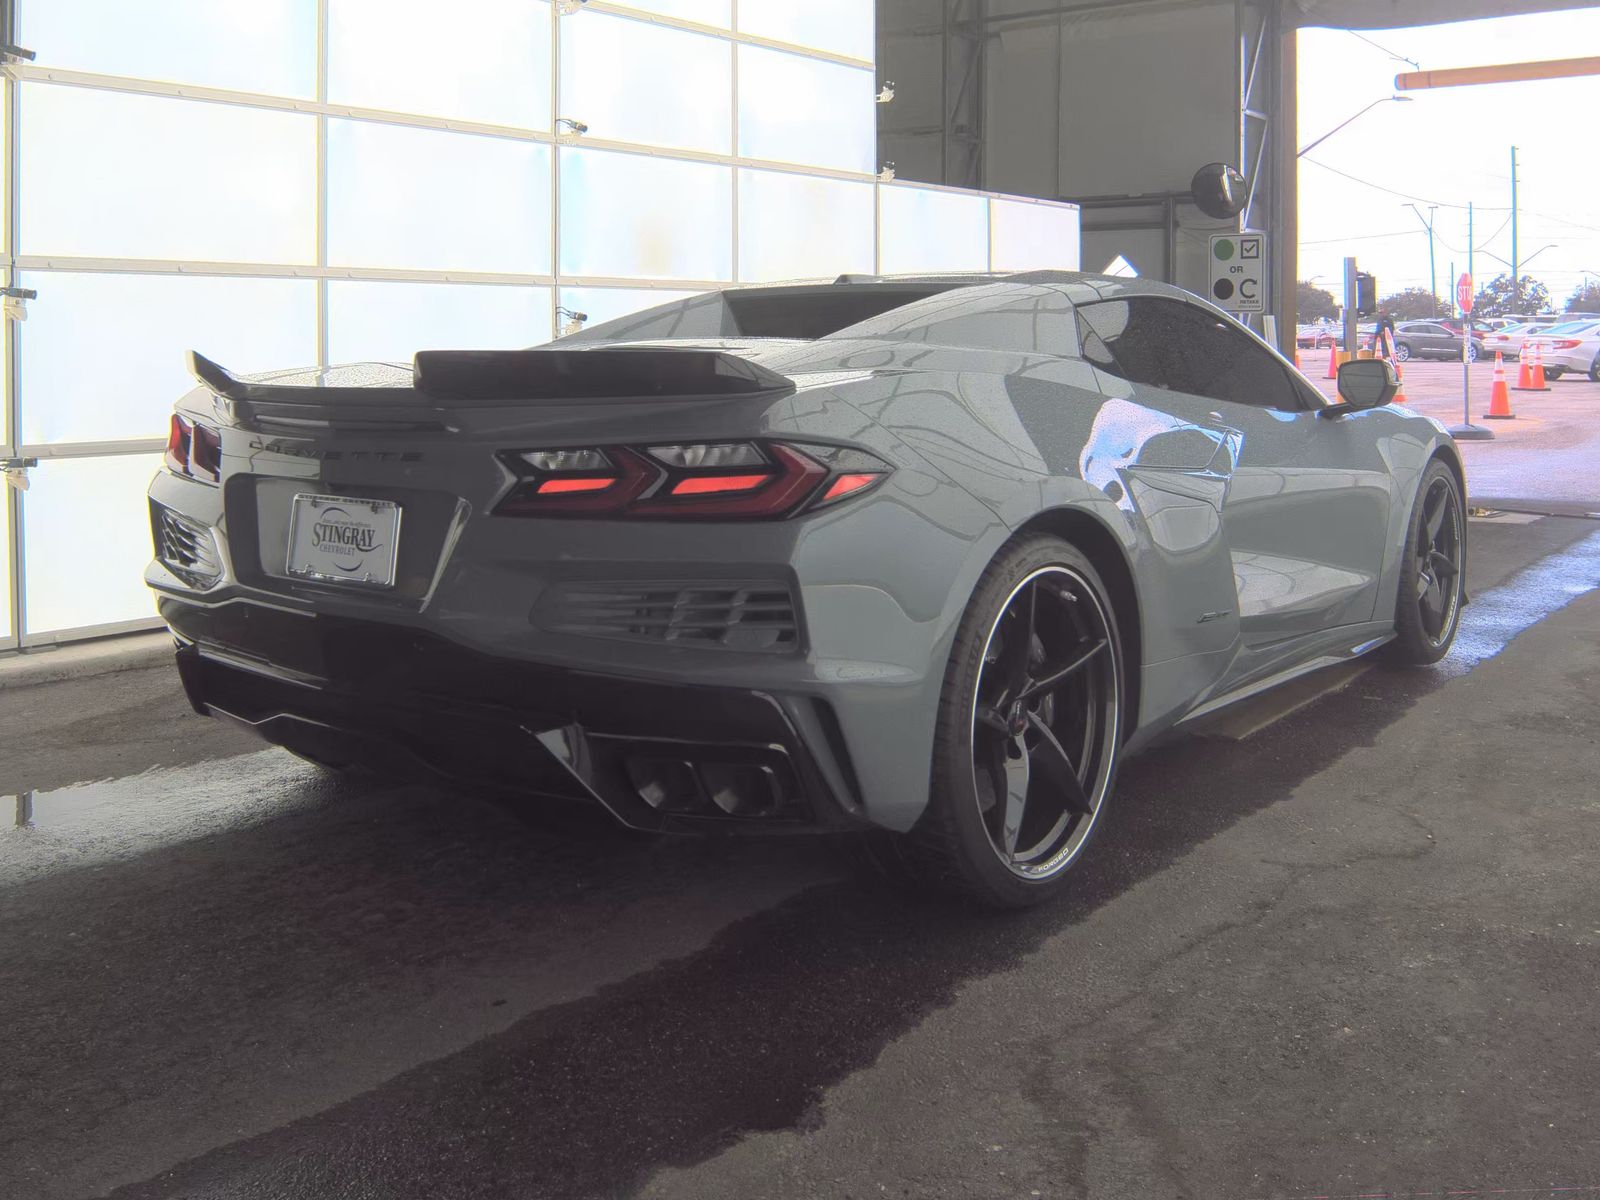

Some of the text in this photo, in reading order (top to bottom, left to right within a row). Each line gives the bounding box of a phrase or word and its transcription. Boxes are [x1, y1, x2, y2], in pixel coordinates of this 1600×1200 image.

[1229, 265, 1244, 274] OR
[1457, 285, 1473, 301] STO
[249, 441, 425, 462] CORVETTE
[312, 522, 383, 552] STINGRAY
[319, 543, 356, 556] CHEVROLET
